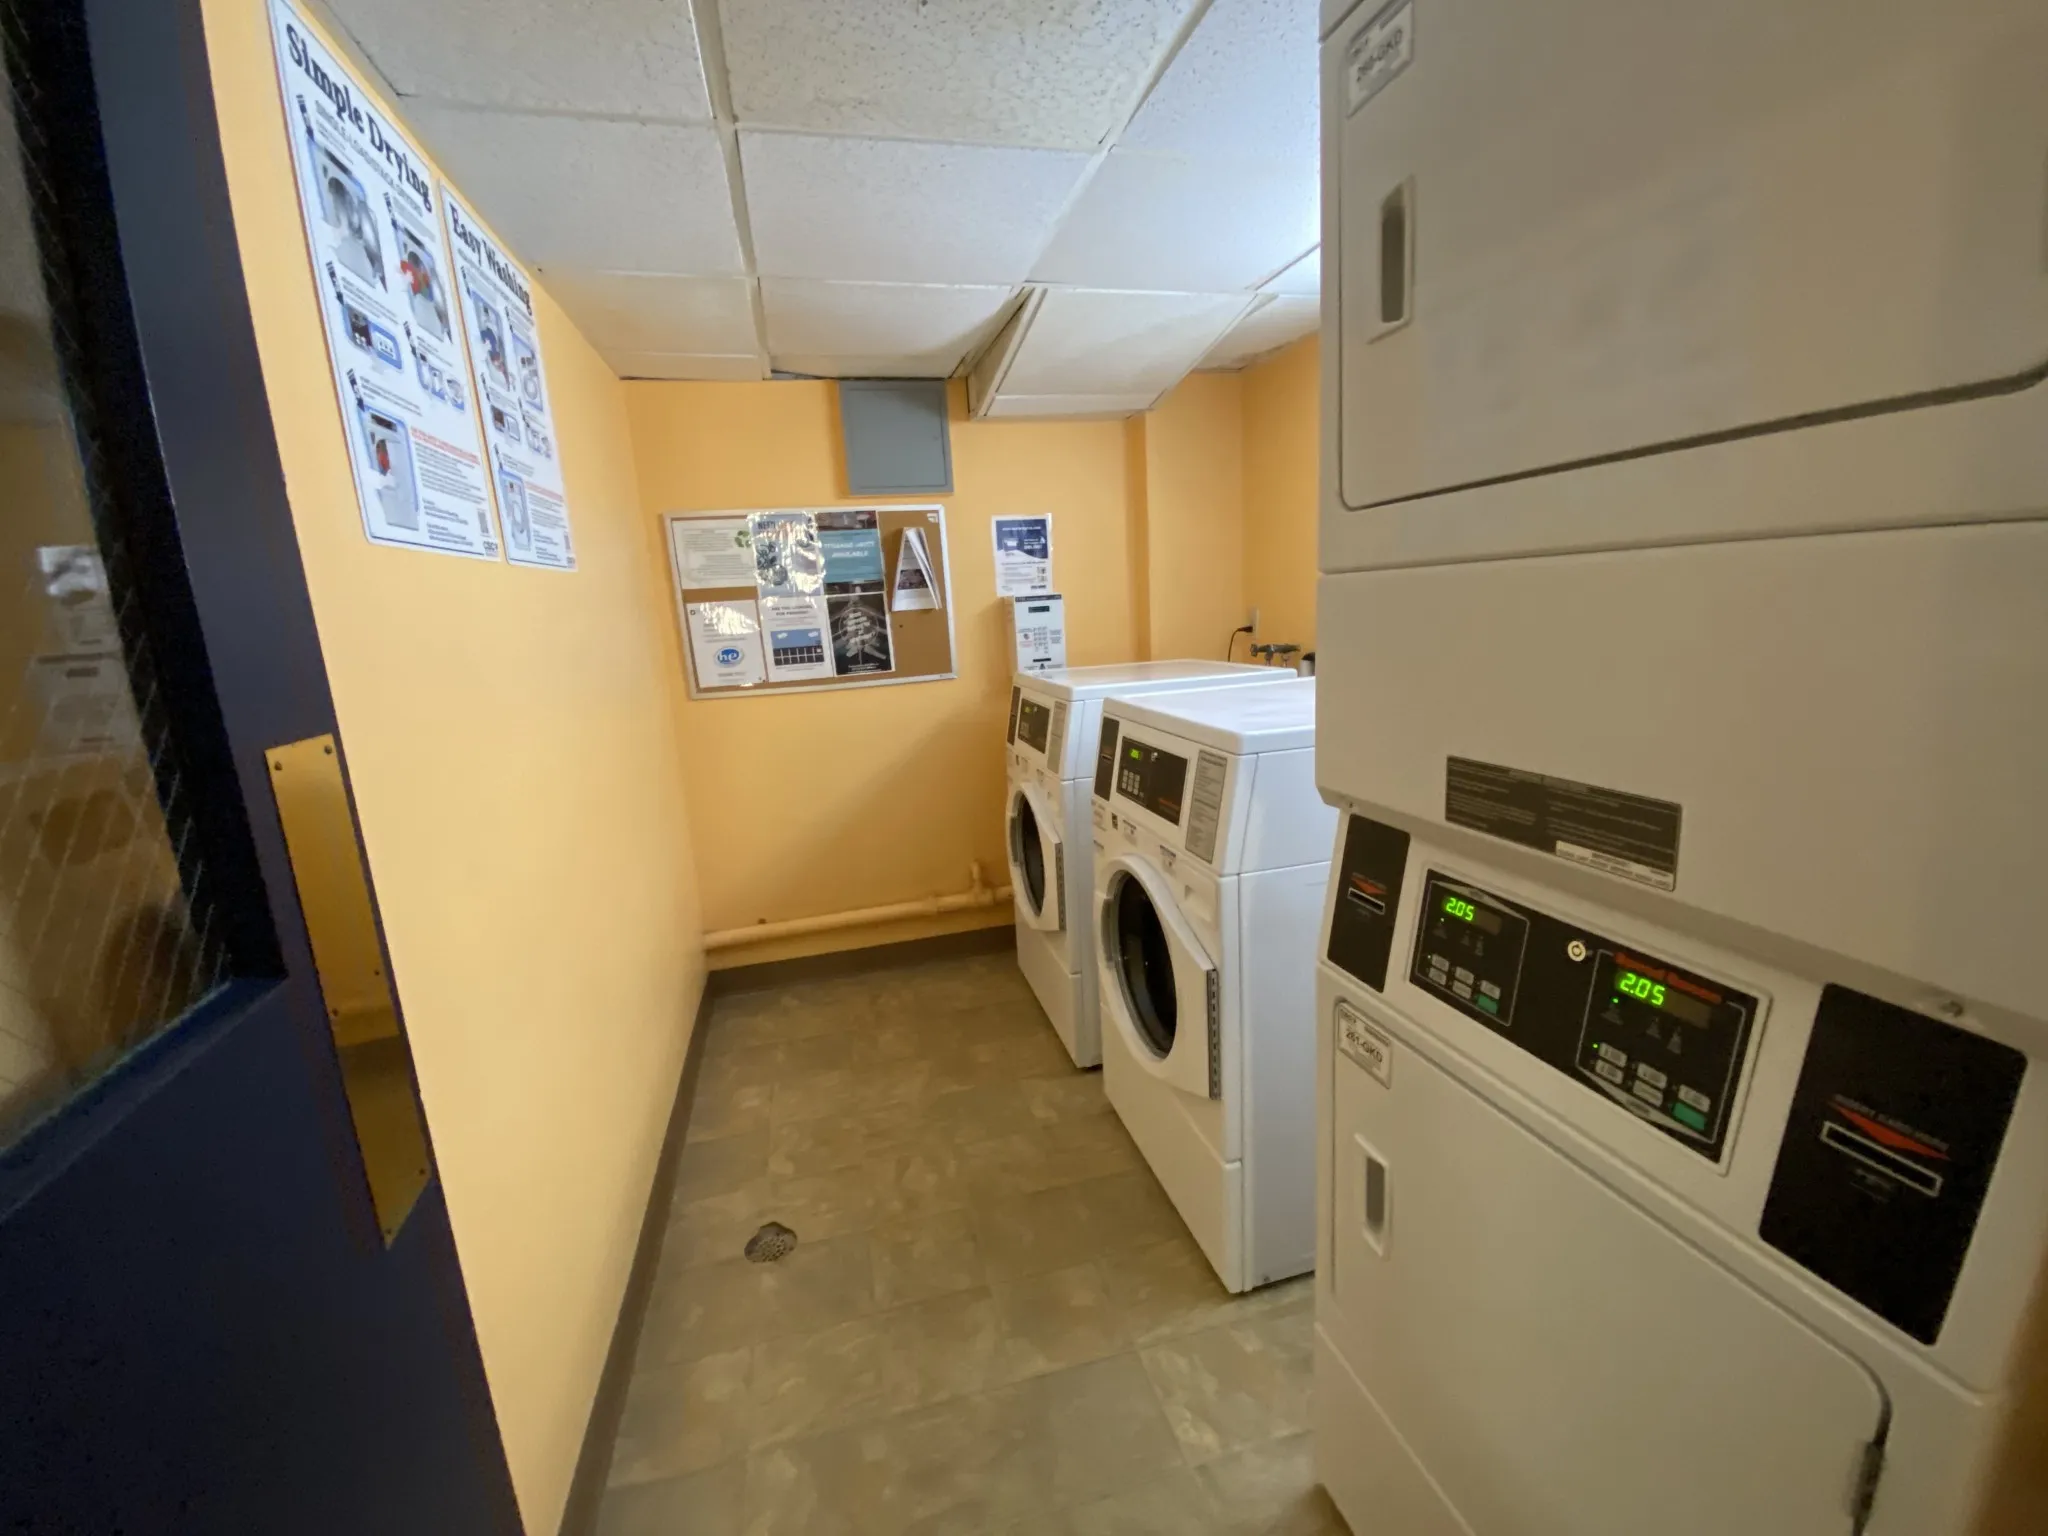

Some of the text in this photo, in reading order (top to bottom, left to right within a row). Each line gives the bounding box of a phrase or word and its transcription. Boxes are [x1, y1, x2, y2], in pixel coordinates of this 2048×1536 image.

[286, 23, 364, 134] Simple
[365, 111, 433, 214] Drying
[449, 202, 482, 266] Easy
[482, 240, 533, 316] Washing
[1446, 897, 1475, 921] 2.05
[1620, 972, 1666, 1006] 2.05
